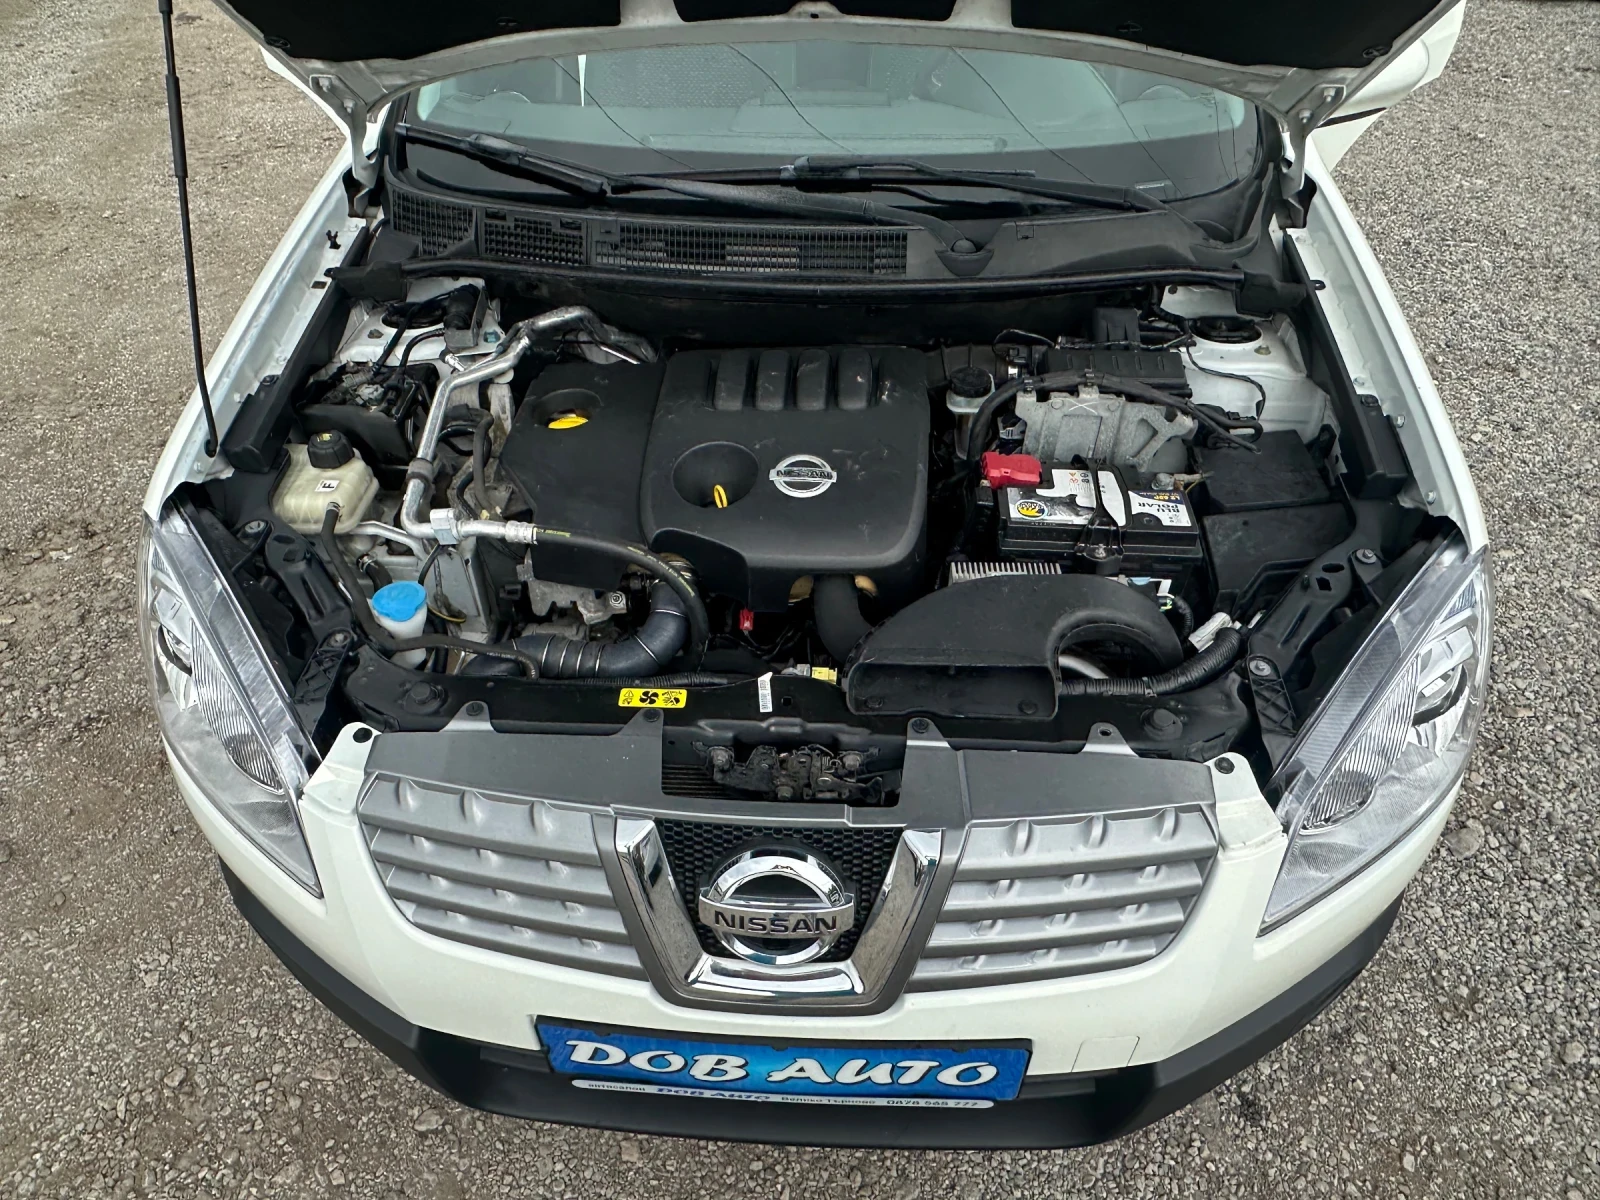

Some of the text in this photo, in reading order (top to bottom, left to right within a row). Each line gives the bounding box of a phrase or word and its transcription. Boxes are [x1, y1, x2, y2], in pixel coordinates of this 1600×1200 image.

[776, 469, 834, 480] NISSAN
[714, 909, 837, 934] NISSAN
[565, 1040, 999, 1087] DOB AUTO
[656, 1087, 704, 1097] DOB
[710, 1091, 771, 1101] AUTO
